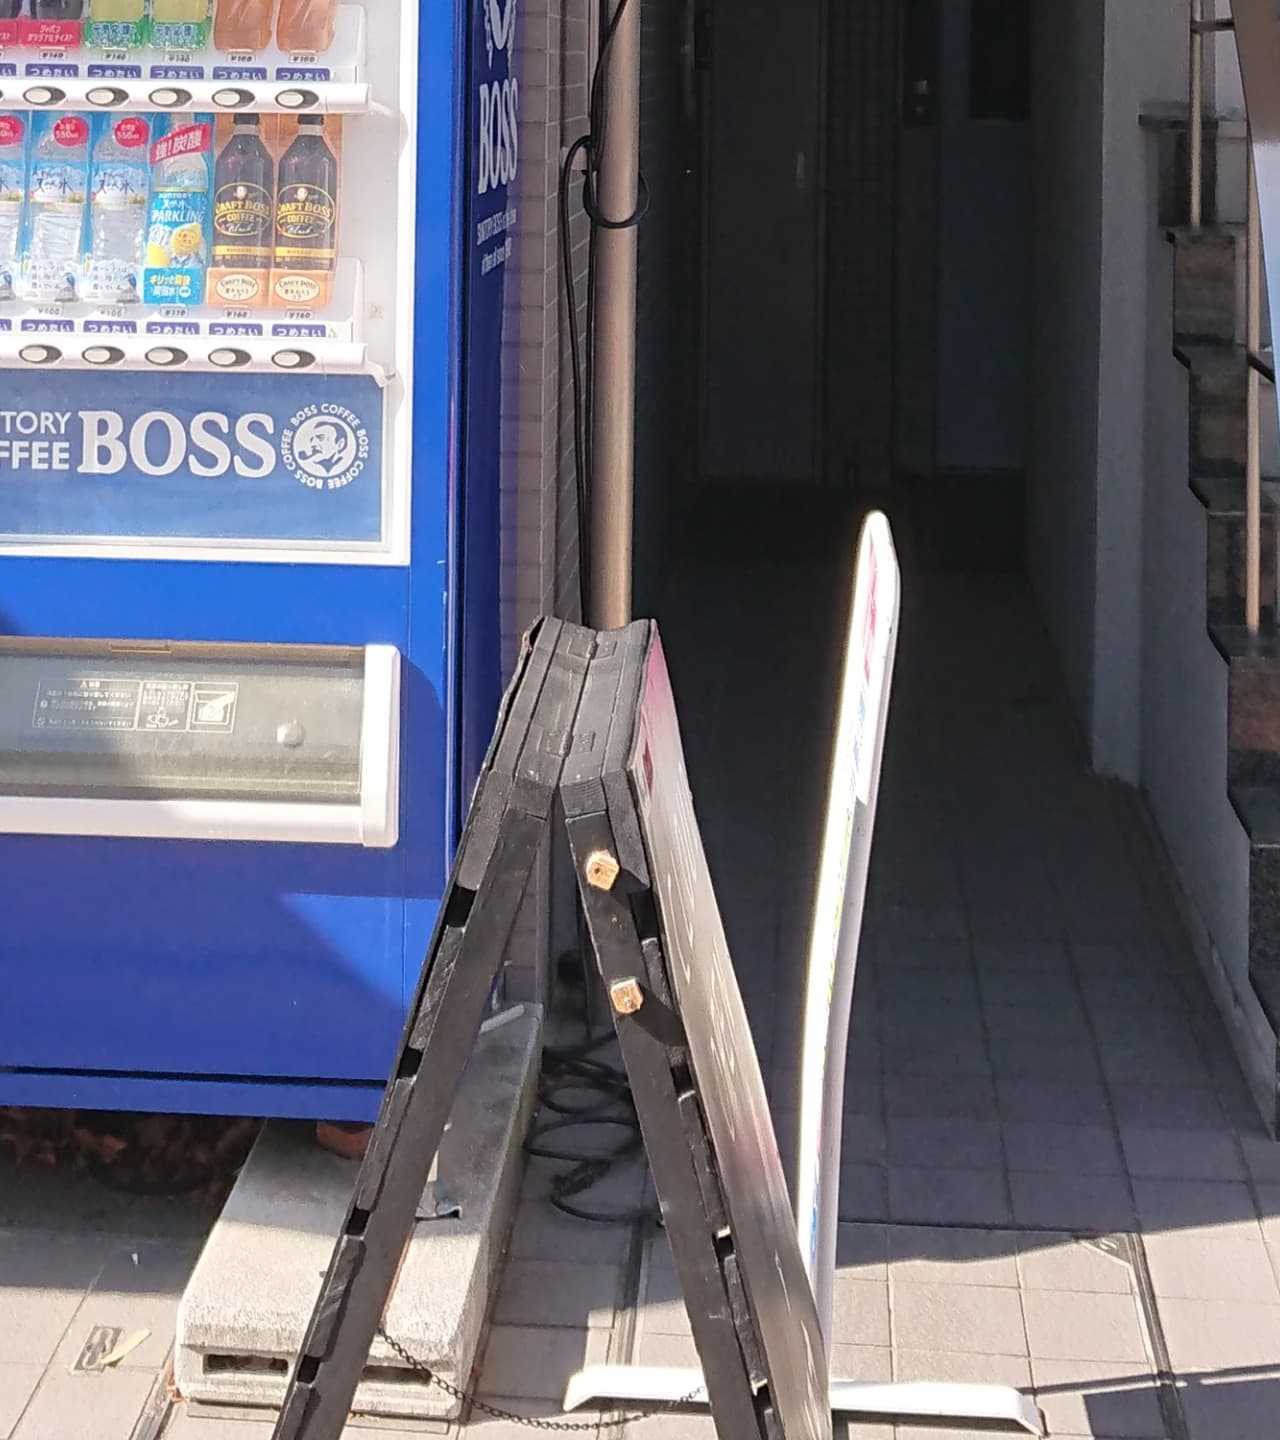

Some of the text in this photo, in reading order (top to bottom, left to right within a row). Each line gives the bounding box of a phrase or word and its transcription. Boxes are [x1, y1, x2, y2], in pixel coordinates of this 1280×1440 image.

[477, 77, 519, 196] BOSS
[290, 404, 318, 426] BOSS
[321, 403, 361, 428] COFFEE
[77, 409, 276, 478] BOSS
[281, 428, 296, 471] COFFEE
[356, 428, 369, 459] BOSS
